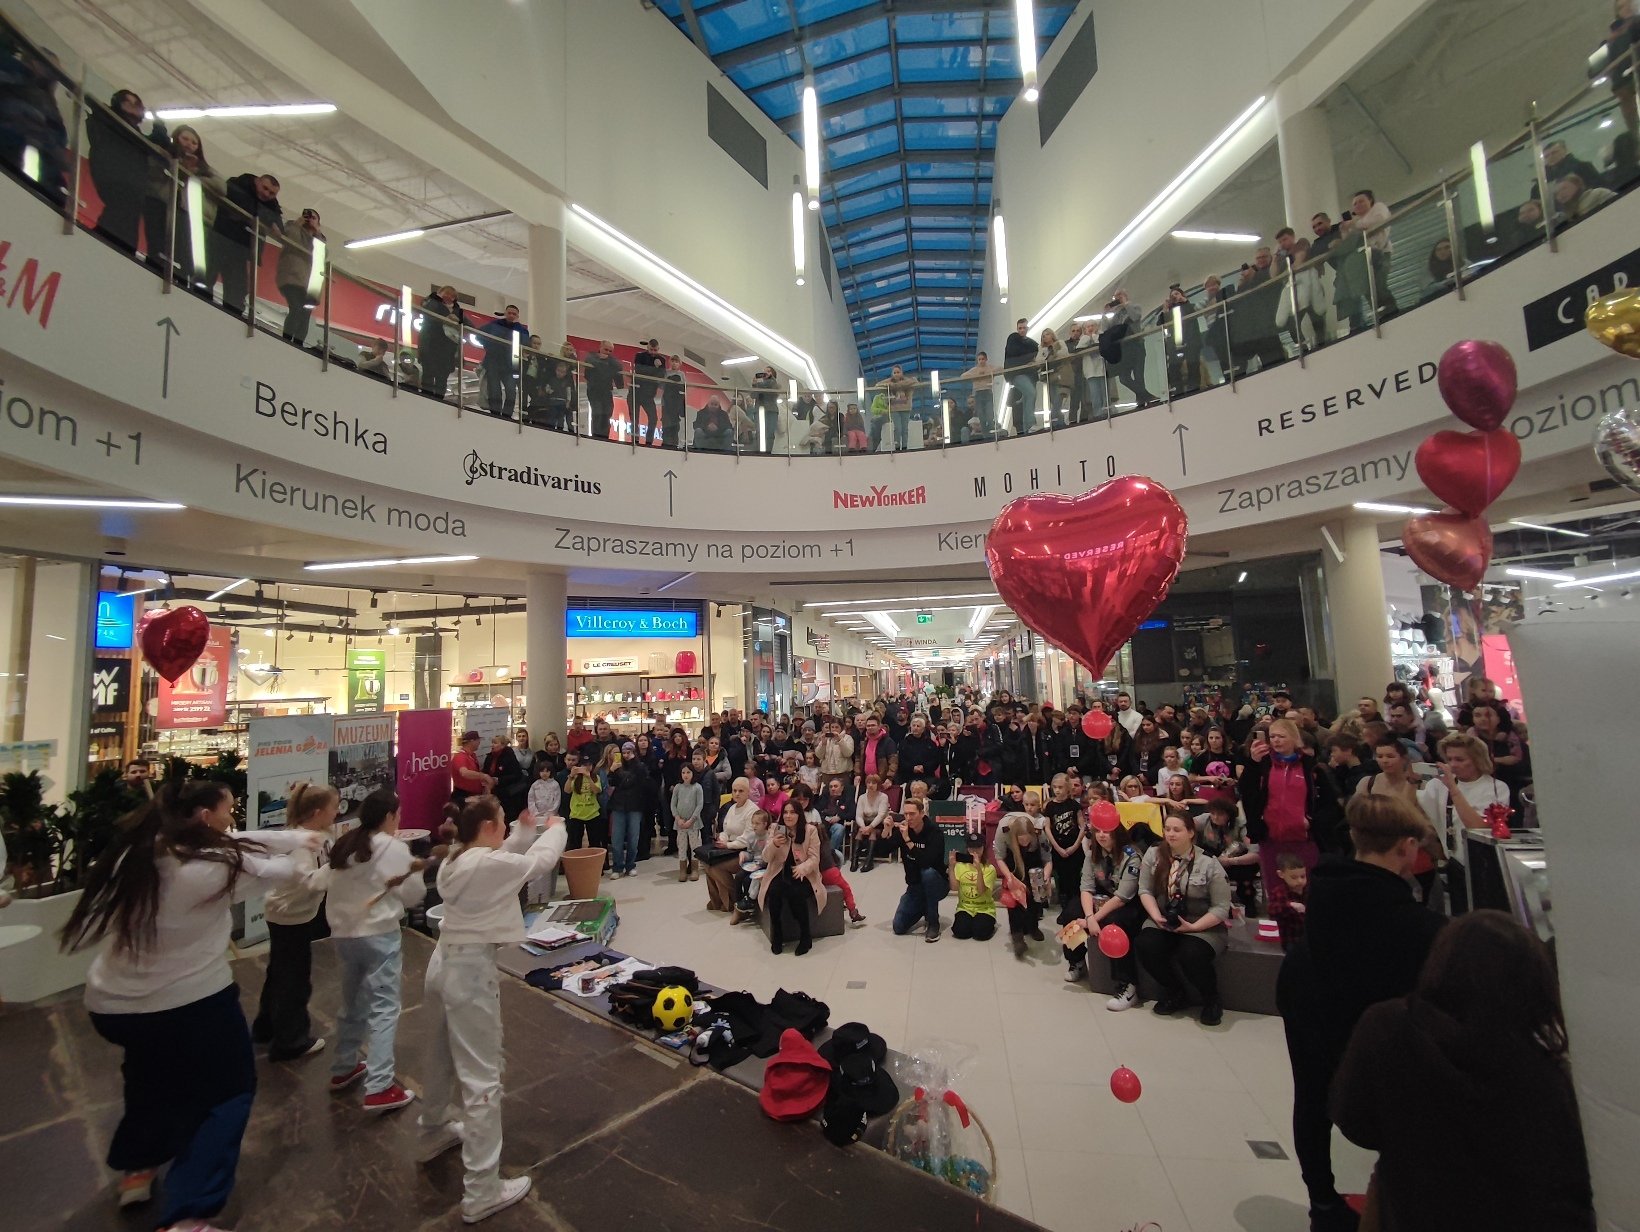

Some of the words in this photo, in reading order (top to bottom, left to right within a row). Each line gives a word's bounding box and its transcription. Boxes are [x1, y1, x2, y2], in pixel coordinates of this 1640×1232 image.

[1257, 361, 1438, 437] RESERVED
[1509, 377, 1640, 441] oziom
[254, 380, 389, 455] Bershka
[95, 431, 142, 466] +1
[479, 460, 602, 496] stradivarius
[974, 455, 1117, 498] MOHITO
[1218, 450, 1412, 515] Zapraszamy
[235, 463, 377, 524] Kierunek
[387, 505, 467, 538] moda
[554, 527, 699, 563] Zapraszamy
[706, 540, 734, 559] na
[741, 540, 822, 563] poziom
[829, 538, 855, 558] +1
[937, 531, 987, 552] Kier
[576, 615, 635, 632] Villeroy
[639, 618, 649, 629] &
[652, 616, 688, 629] Boch
[914, 638, 938, 646] WINDA
[254, 744, 293, 758] JELENIA
[337, 723, 389, 745] MUZEUM
[411, 751, 449, 773] hebe
